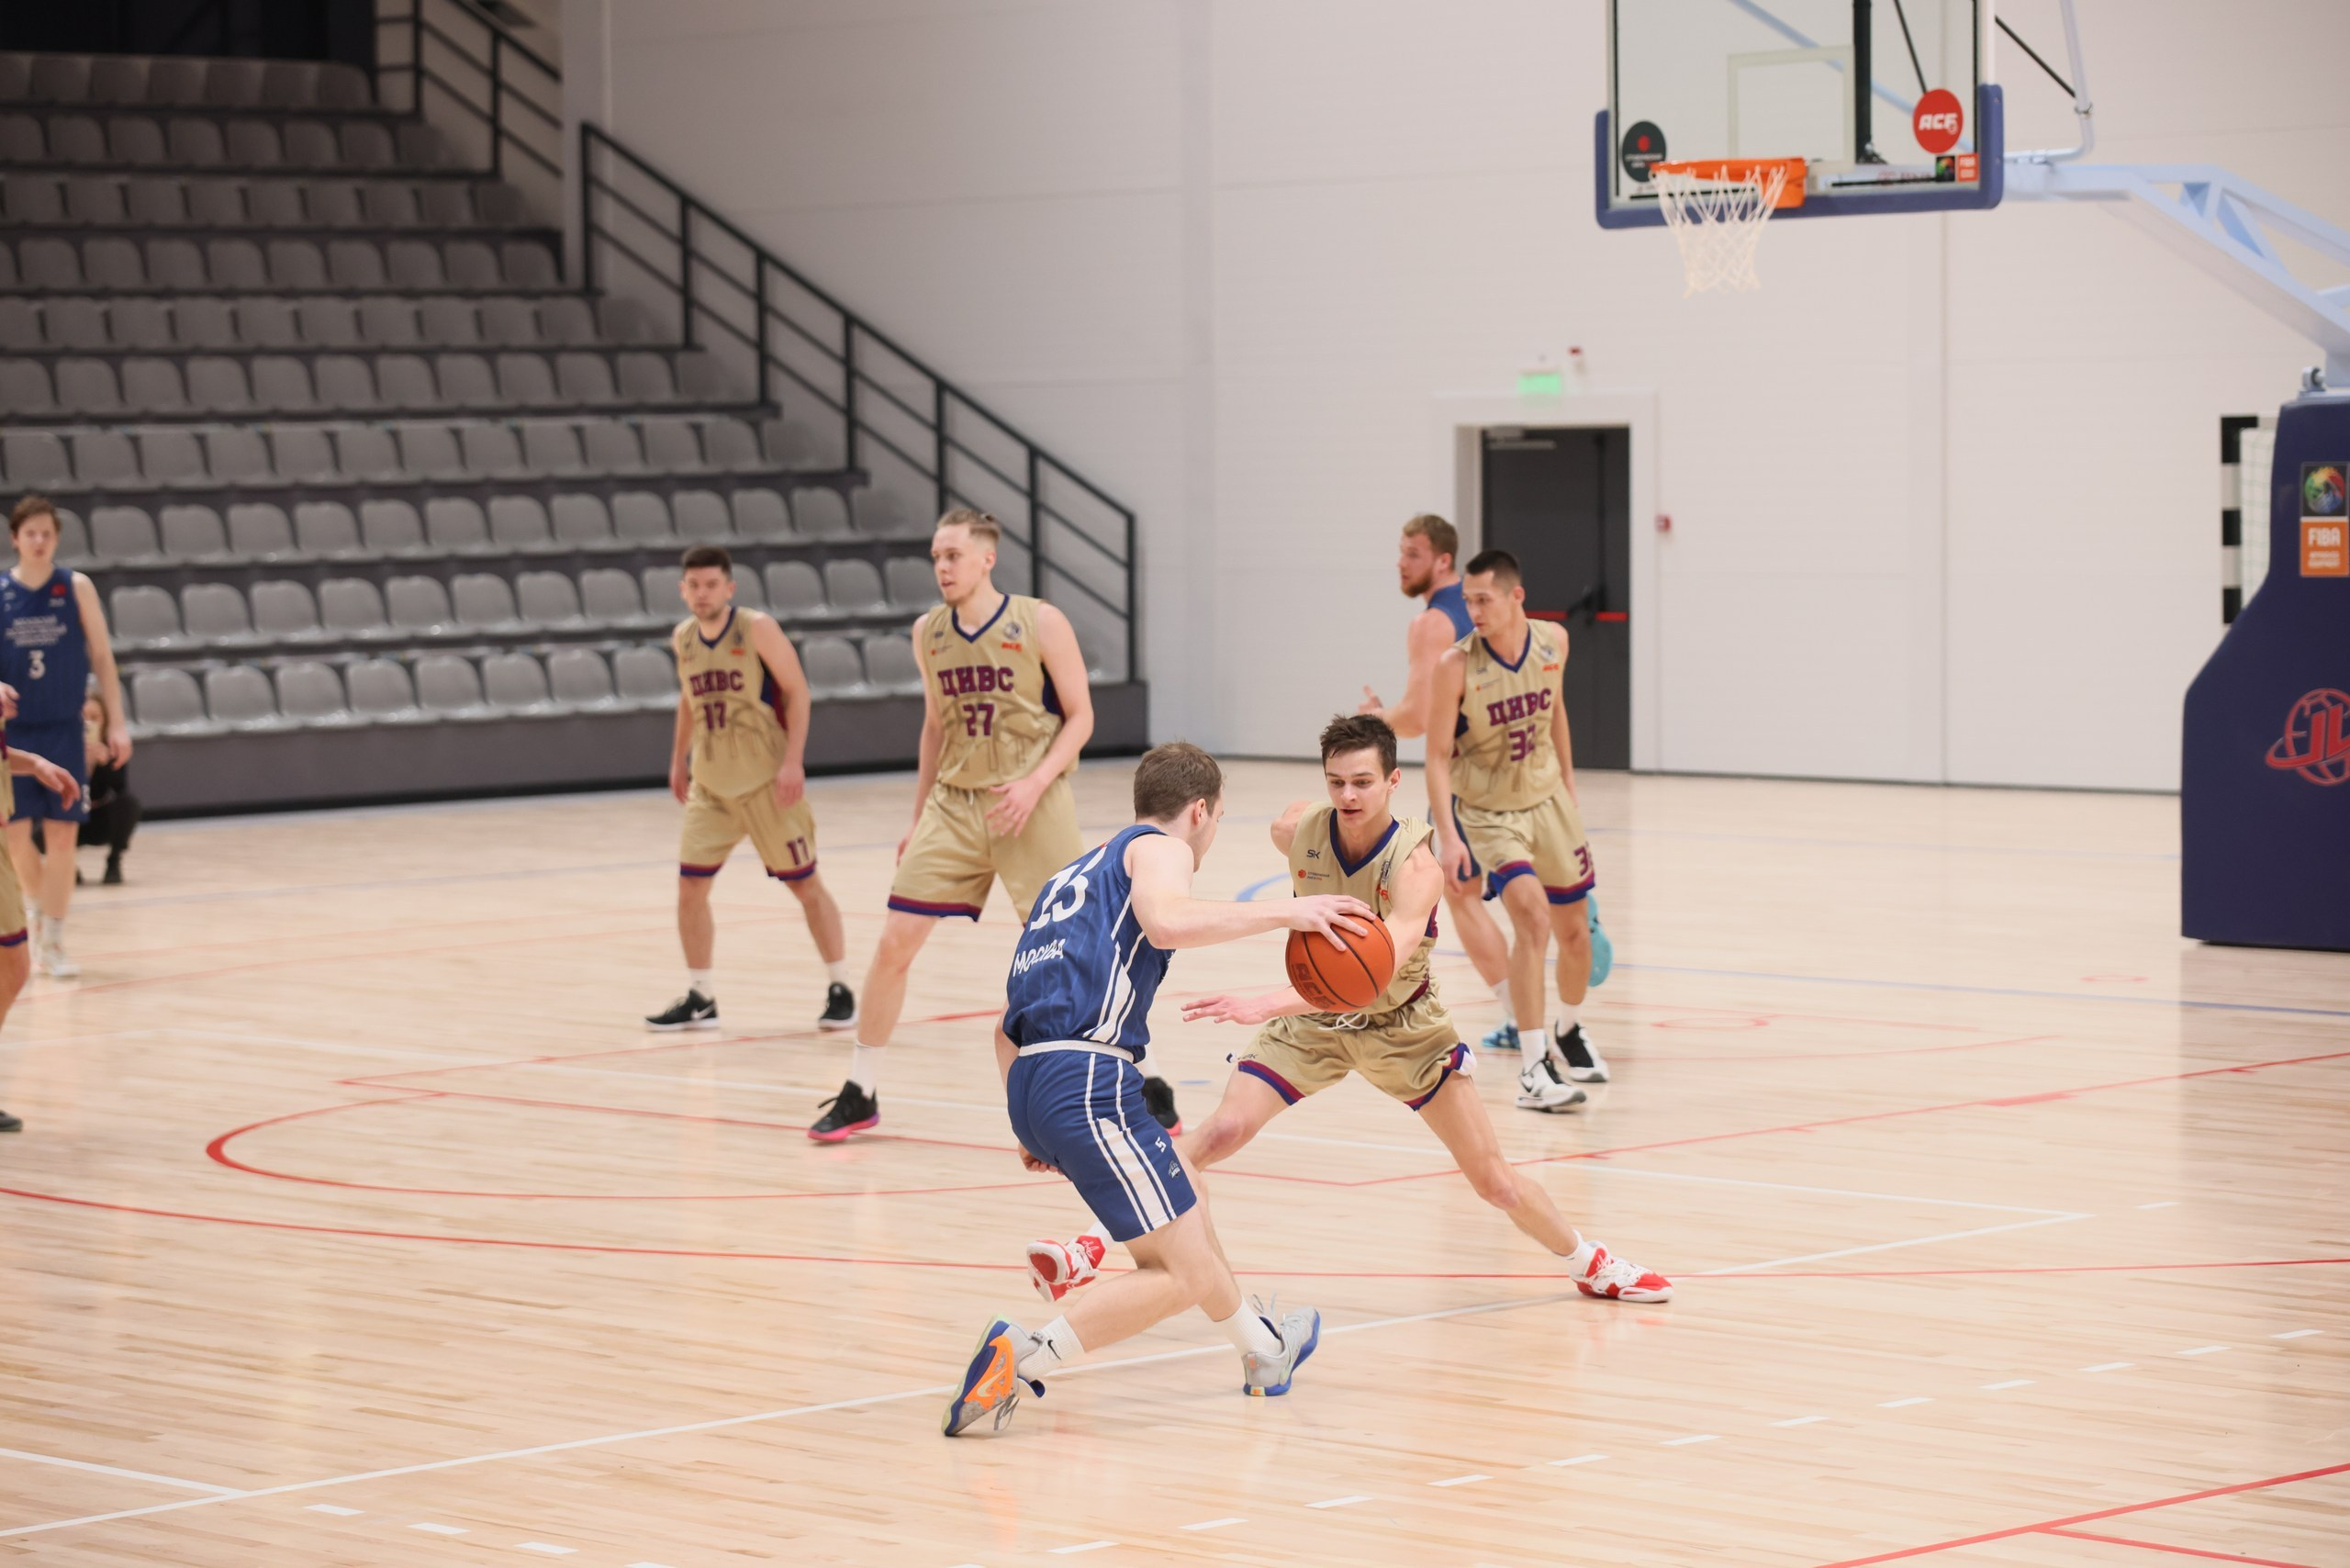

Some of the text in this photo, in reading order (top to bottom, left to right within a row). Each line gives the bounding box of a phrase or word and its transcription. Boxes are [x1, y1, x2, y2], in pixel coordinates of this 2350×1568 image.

[2308, 527, 2342, 548] FIBA
[28, 649, 45, 679] 3
[703, 700, 726, 731] 17
[962, 703, 995, 737] 27
